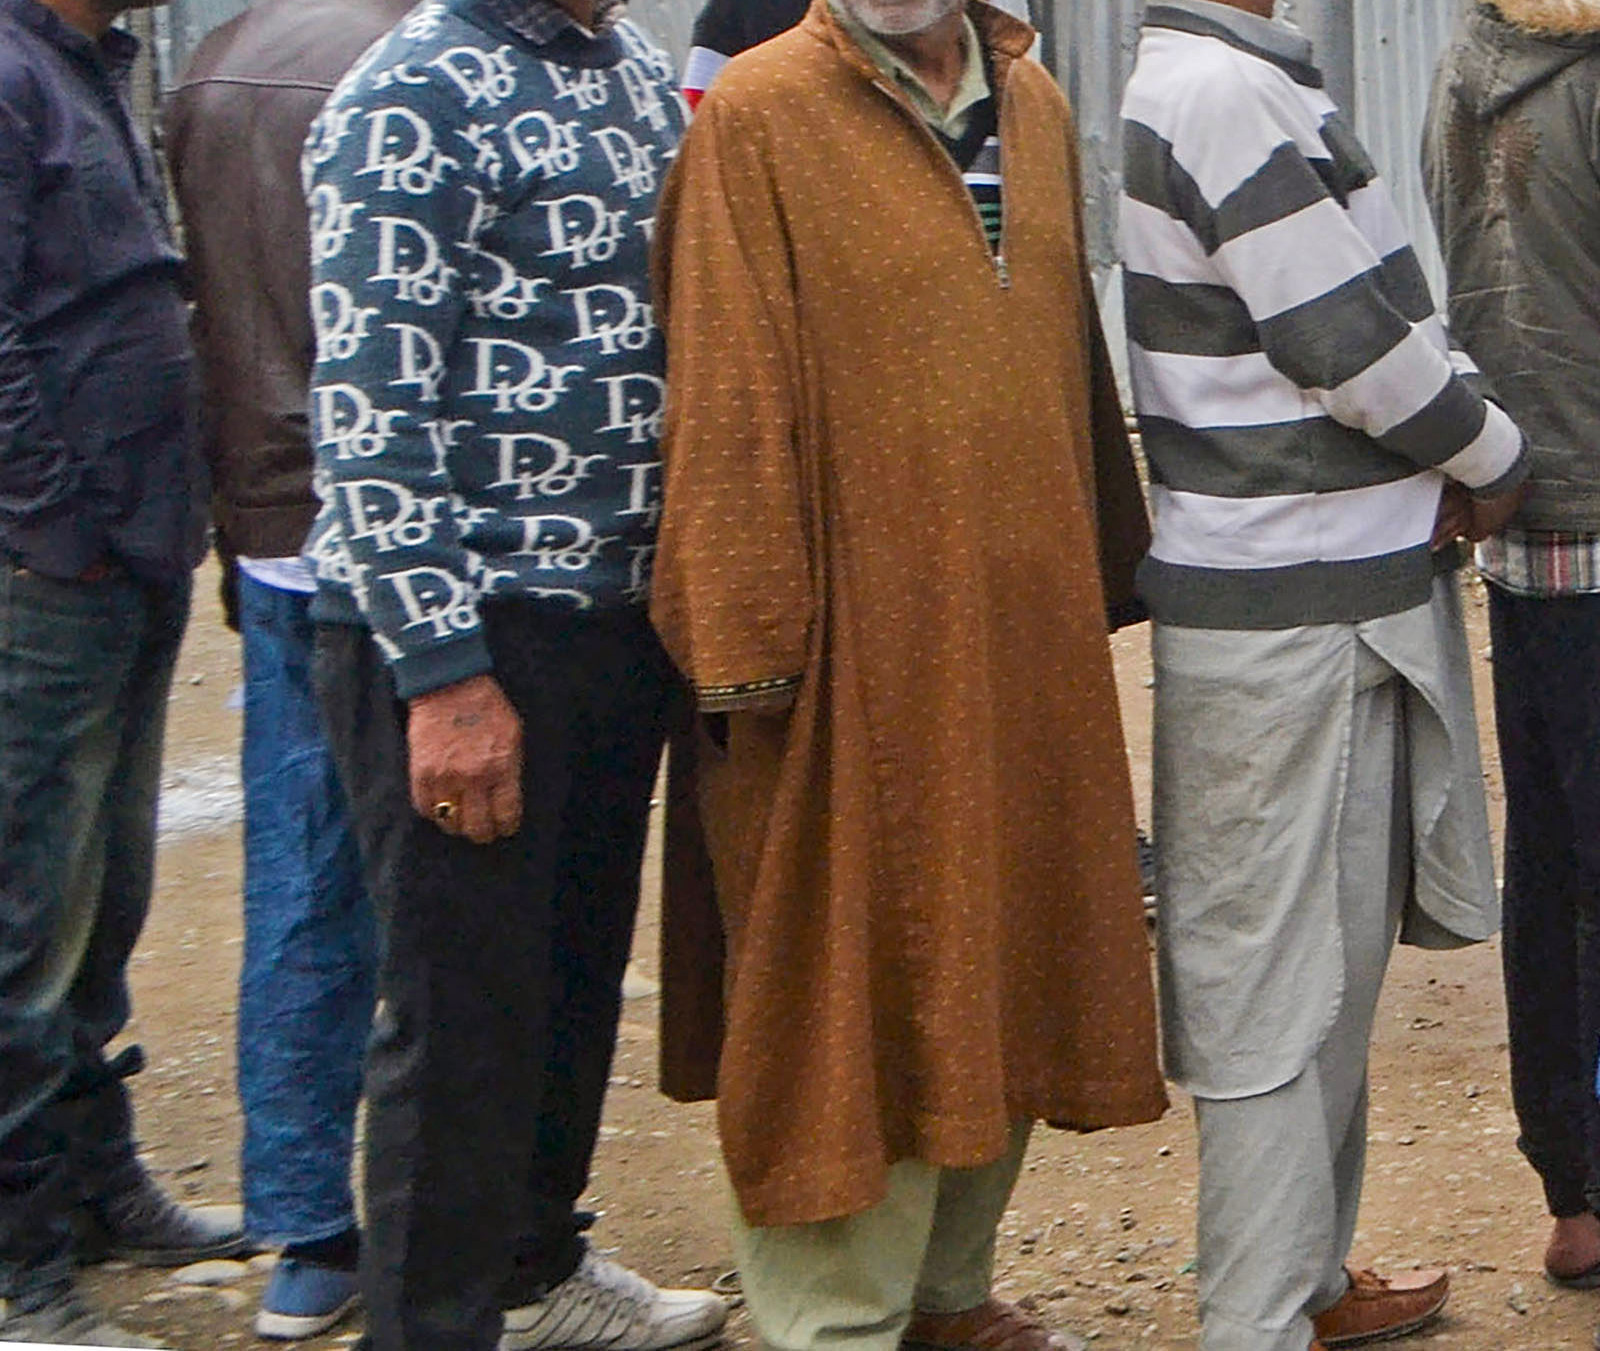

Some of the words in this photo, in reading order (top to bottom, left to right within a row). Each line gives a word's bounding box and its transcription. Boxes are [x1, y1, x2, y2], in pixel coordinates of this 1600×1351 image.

[426, 45, 517, 108] Dior
[354, 106, 460, 194] Dior
[503, 110, 582, 179] Dior
[589, 127, 656, 198] Dior
[367, 216, 460, 306] Dior
[533, 194, 628, 269] Dior
[309, 282, 381, 363] Dior
[460, 337, 585, 413] Dior
[312, 383, 409, 460] Dior
[483, 433, 610, 500] Dior
[332, 479, 449, 552] Dior
[500, 514, 622, 570] Dior
